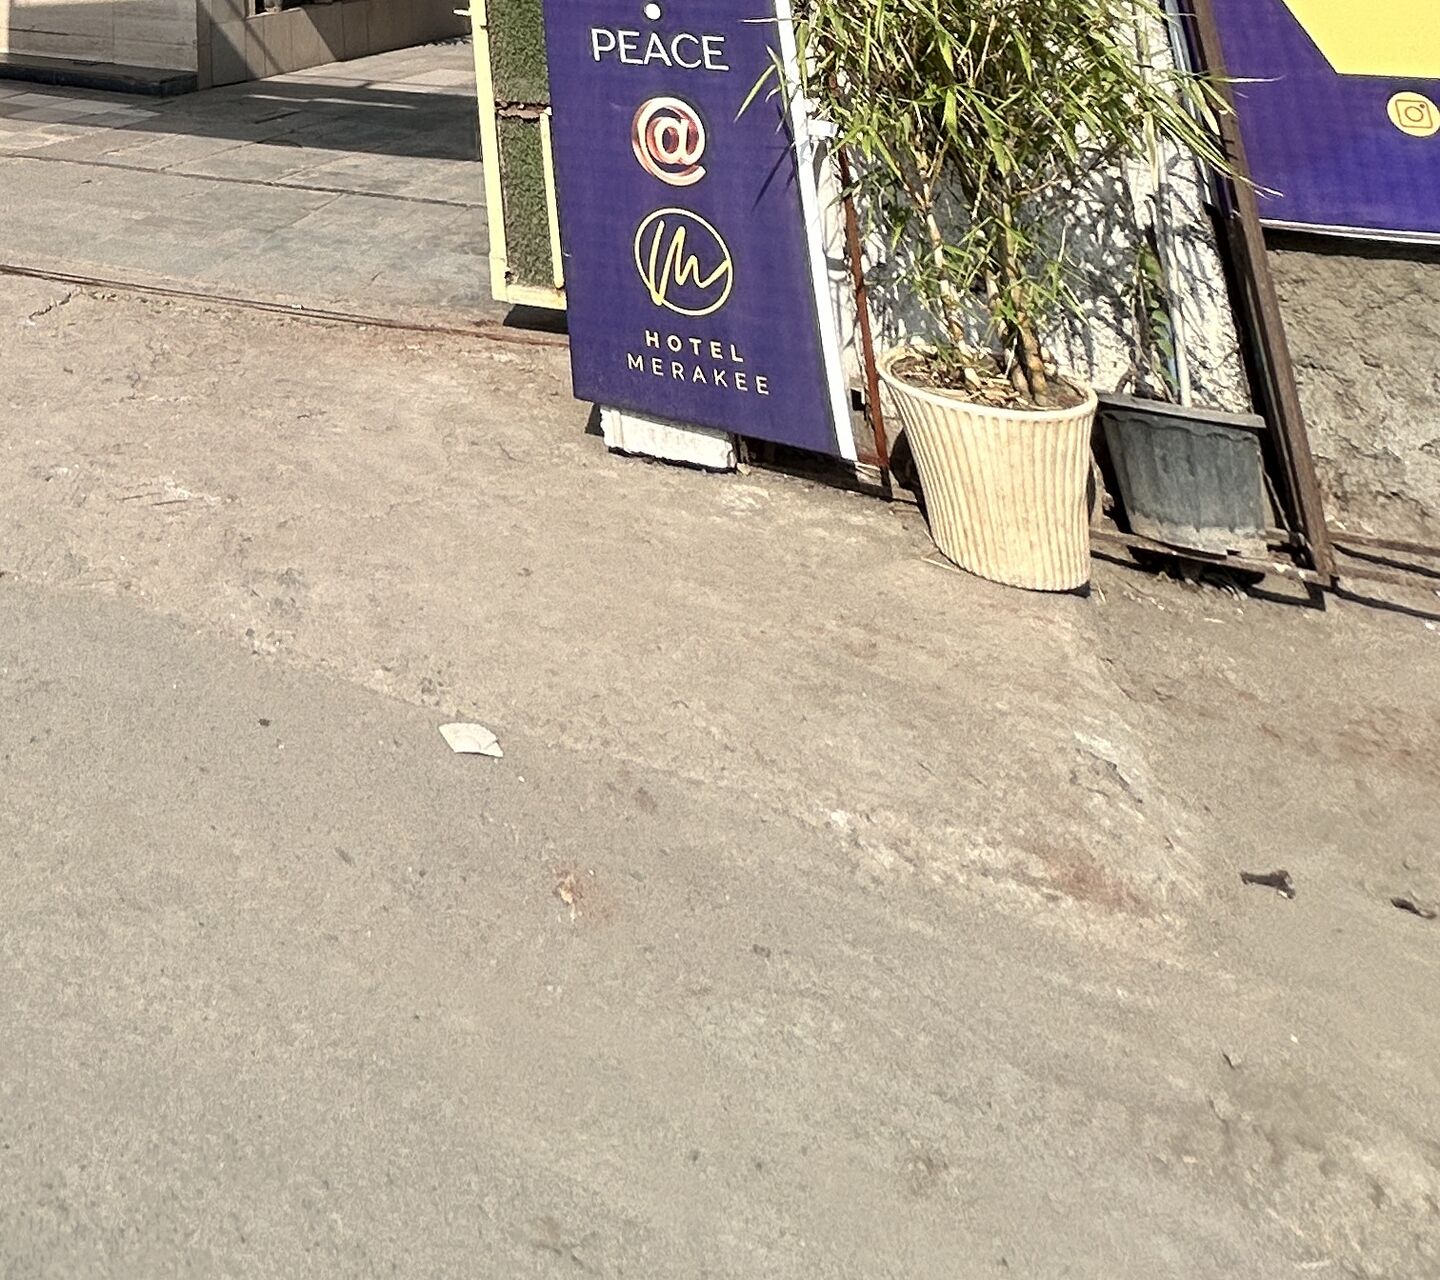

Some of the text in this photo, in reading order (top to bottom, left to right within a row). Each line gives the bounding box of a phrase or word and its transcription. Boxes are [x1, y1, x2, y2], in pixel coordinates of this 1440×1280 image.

[591, 28, 730, 71] PEACE
[631, 96, 707, 187] @
[644, 329, 746, 364] HOTEL
[627, 352, 771, 397] MERAKEE
